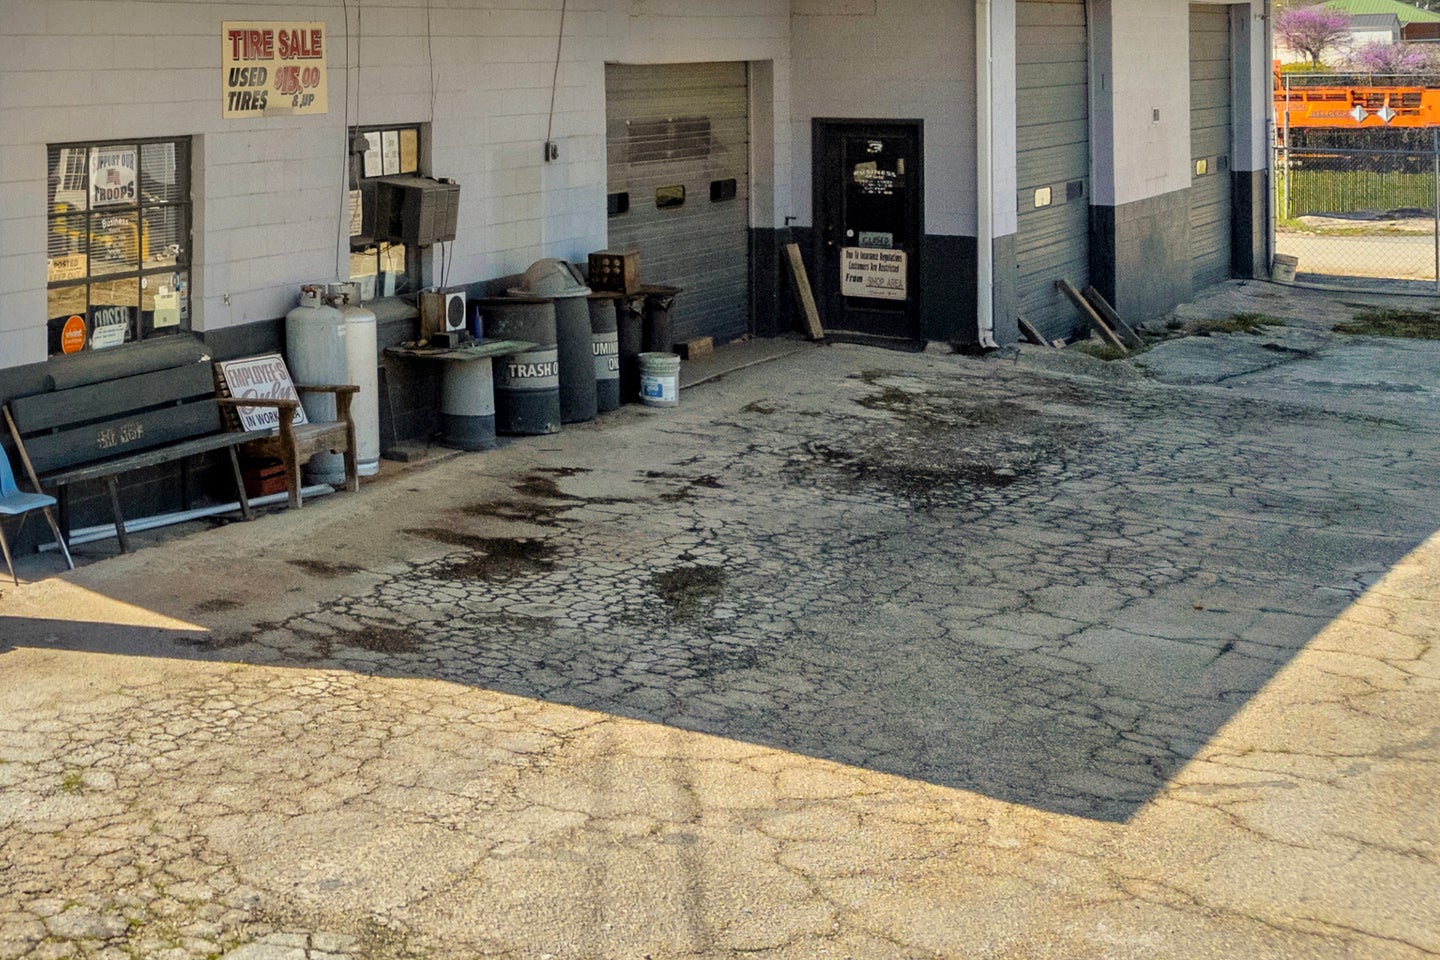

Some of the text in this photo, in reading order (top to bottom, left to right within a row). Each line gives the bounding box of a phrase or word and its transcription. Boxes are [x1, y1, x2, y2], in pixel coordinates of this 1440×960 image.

[228, 29, 323, 61] TIRE SALE
[228, 66, 268, 88] USED
[227, 90, 268, 112] TIRES
[93, 153, 134, 171] UPPORT OUR
[94, 180, 135, 202] TROOPS
[845, 273, 863, 283] From
[94, 306, 128, 328] CLOSED
[508, 362, 552, 378] TRASH
[245, 415, 257, 427] IN
[257, 409, 279, 425] WORK
